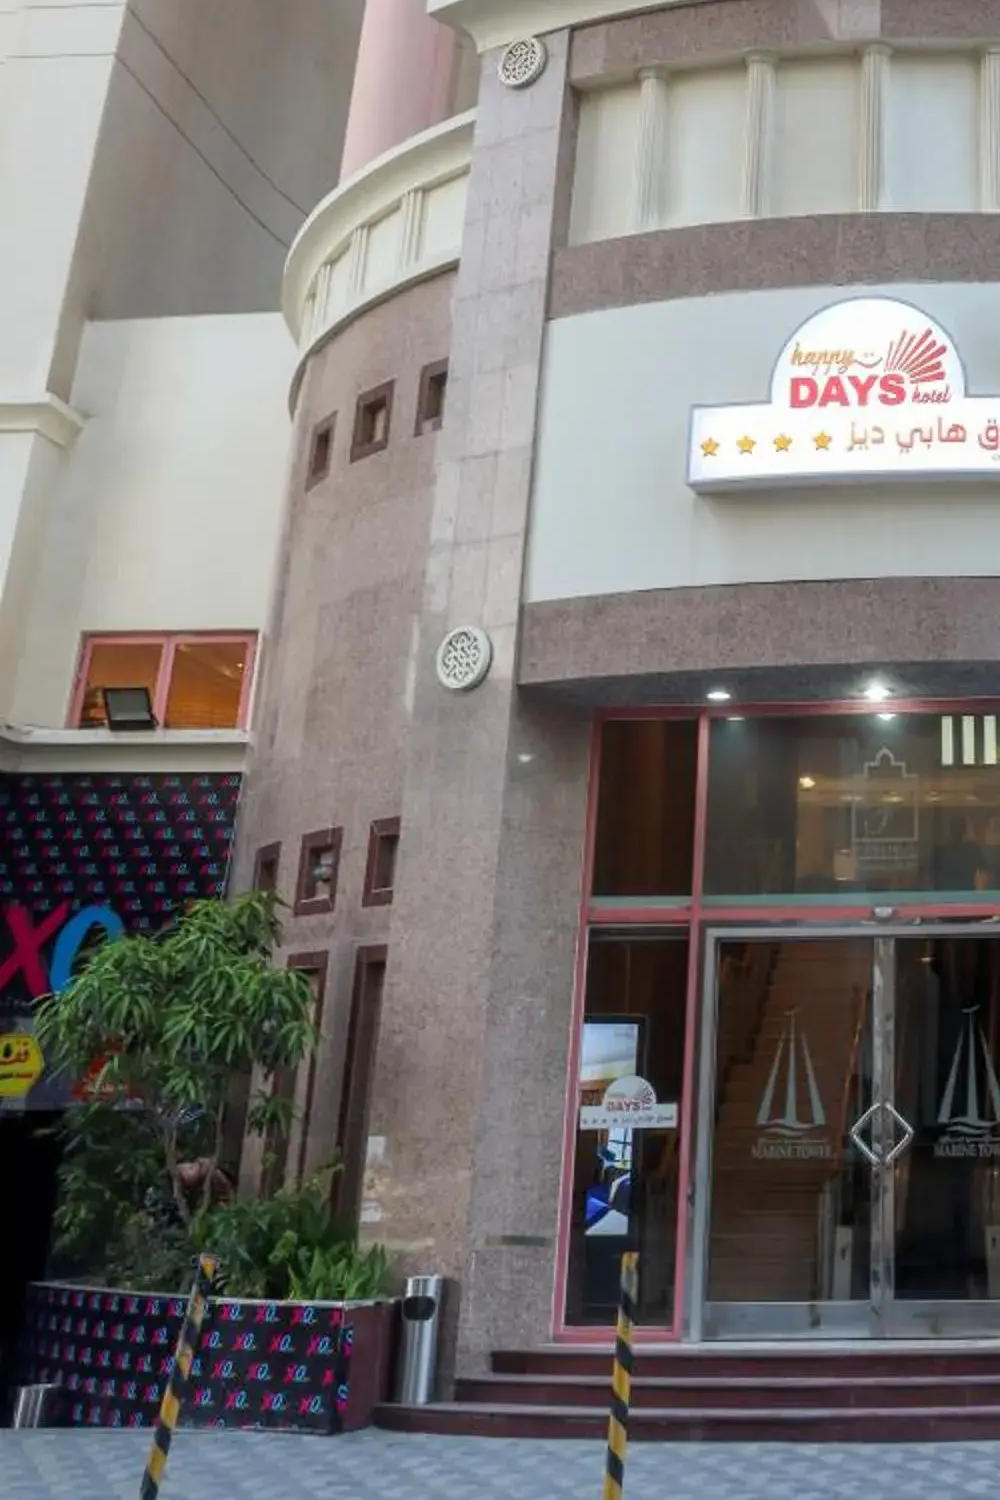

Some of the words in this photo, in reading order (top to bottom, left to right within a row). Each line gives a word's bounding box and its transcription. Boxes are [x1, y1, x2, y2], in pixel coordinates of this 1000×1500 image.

[790, 343, 855, 375] happy
[789, 374, 906, 408] DAYS
[911, 382, 951, 404] hotel
[846, 421, 885, 452] ديز
[896, 417, 966, 454] هابي
